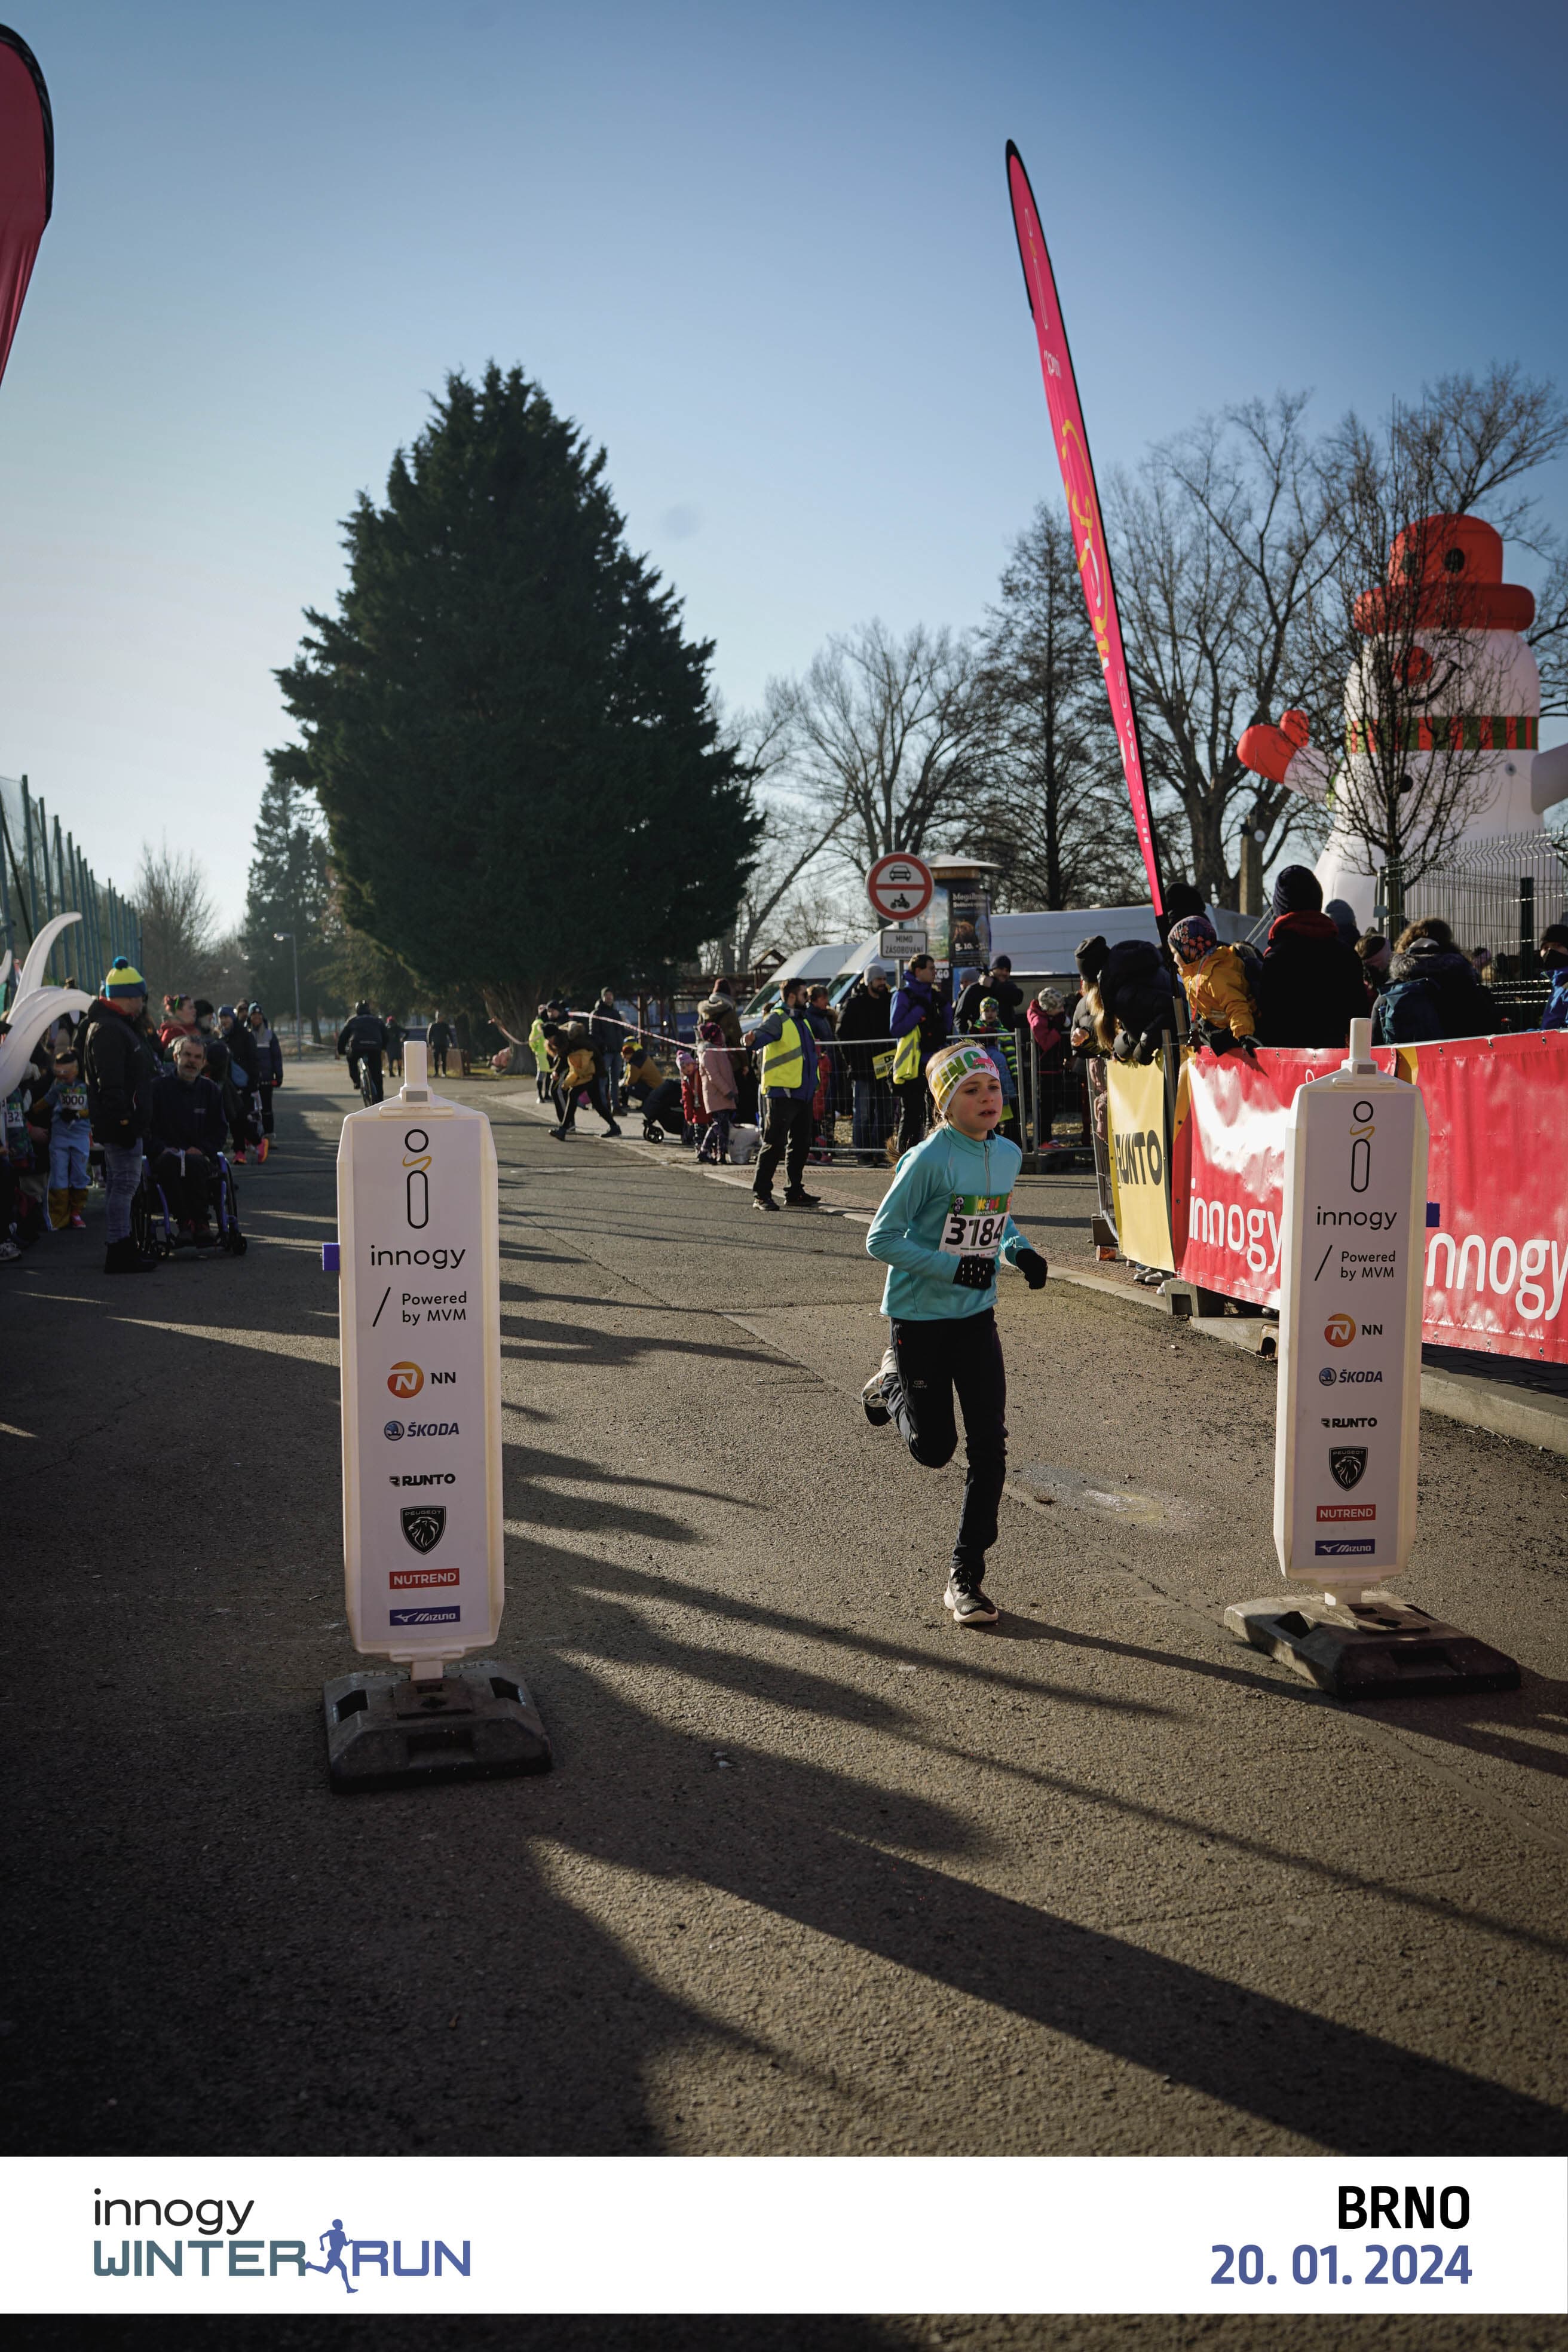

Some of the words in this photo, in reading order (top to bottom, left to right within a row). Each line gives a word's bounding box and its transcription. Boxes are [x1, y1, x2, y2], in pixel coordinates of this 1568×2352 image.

[1316, 1206, 1397, 1230] innogy
[945, 1216, 1005, 1246] 3184
[1189, 1178, 1282, 1275] innogy
[370, 1245, 466, 1269] innogy
[1341, 1251, 1396, 1263] Powered
[1340, 1266, 1356, 1281] by
[1362, 1267, 1395, 1278] MVM
[1426, 1233, 1568, 1320] nnogy
[402, 1291, 467, 1305] Powered
[402, 1309, 420, 1325] by
[427, 1309, 467, 1322] MVM
[1362, 1325, 1383, 1336] NN
[431, 1371, 456, 1385] NN
[1339, 1368, 1383, 1383] ŠKODA
[407, 1422, 460, 1437] ŠKODA
[1332, 1417, 1377, 1428] RUNTO
[402, 1473, 455, 1486] RUNTO
[1320, 1508, 1373, 1518] NUTREND
[394, 1572, 456, 1585] NUTREND
